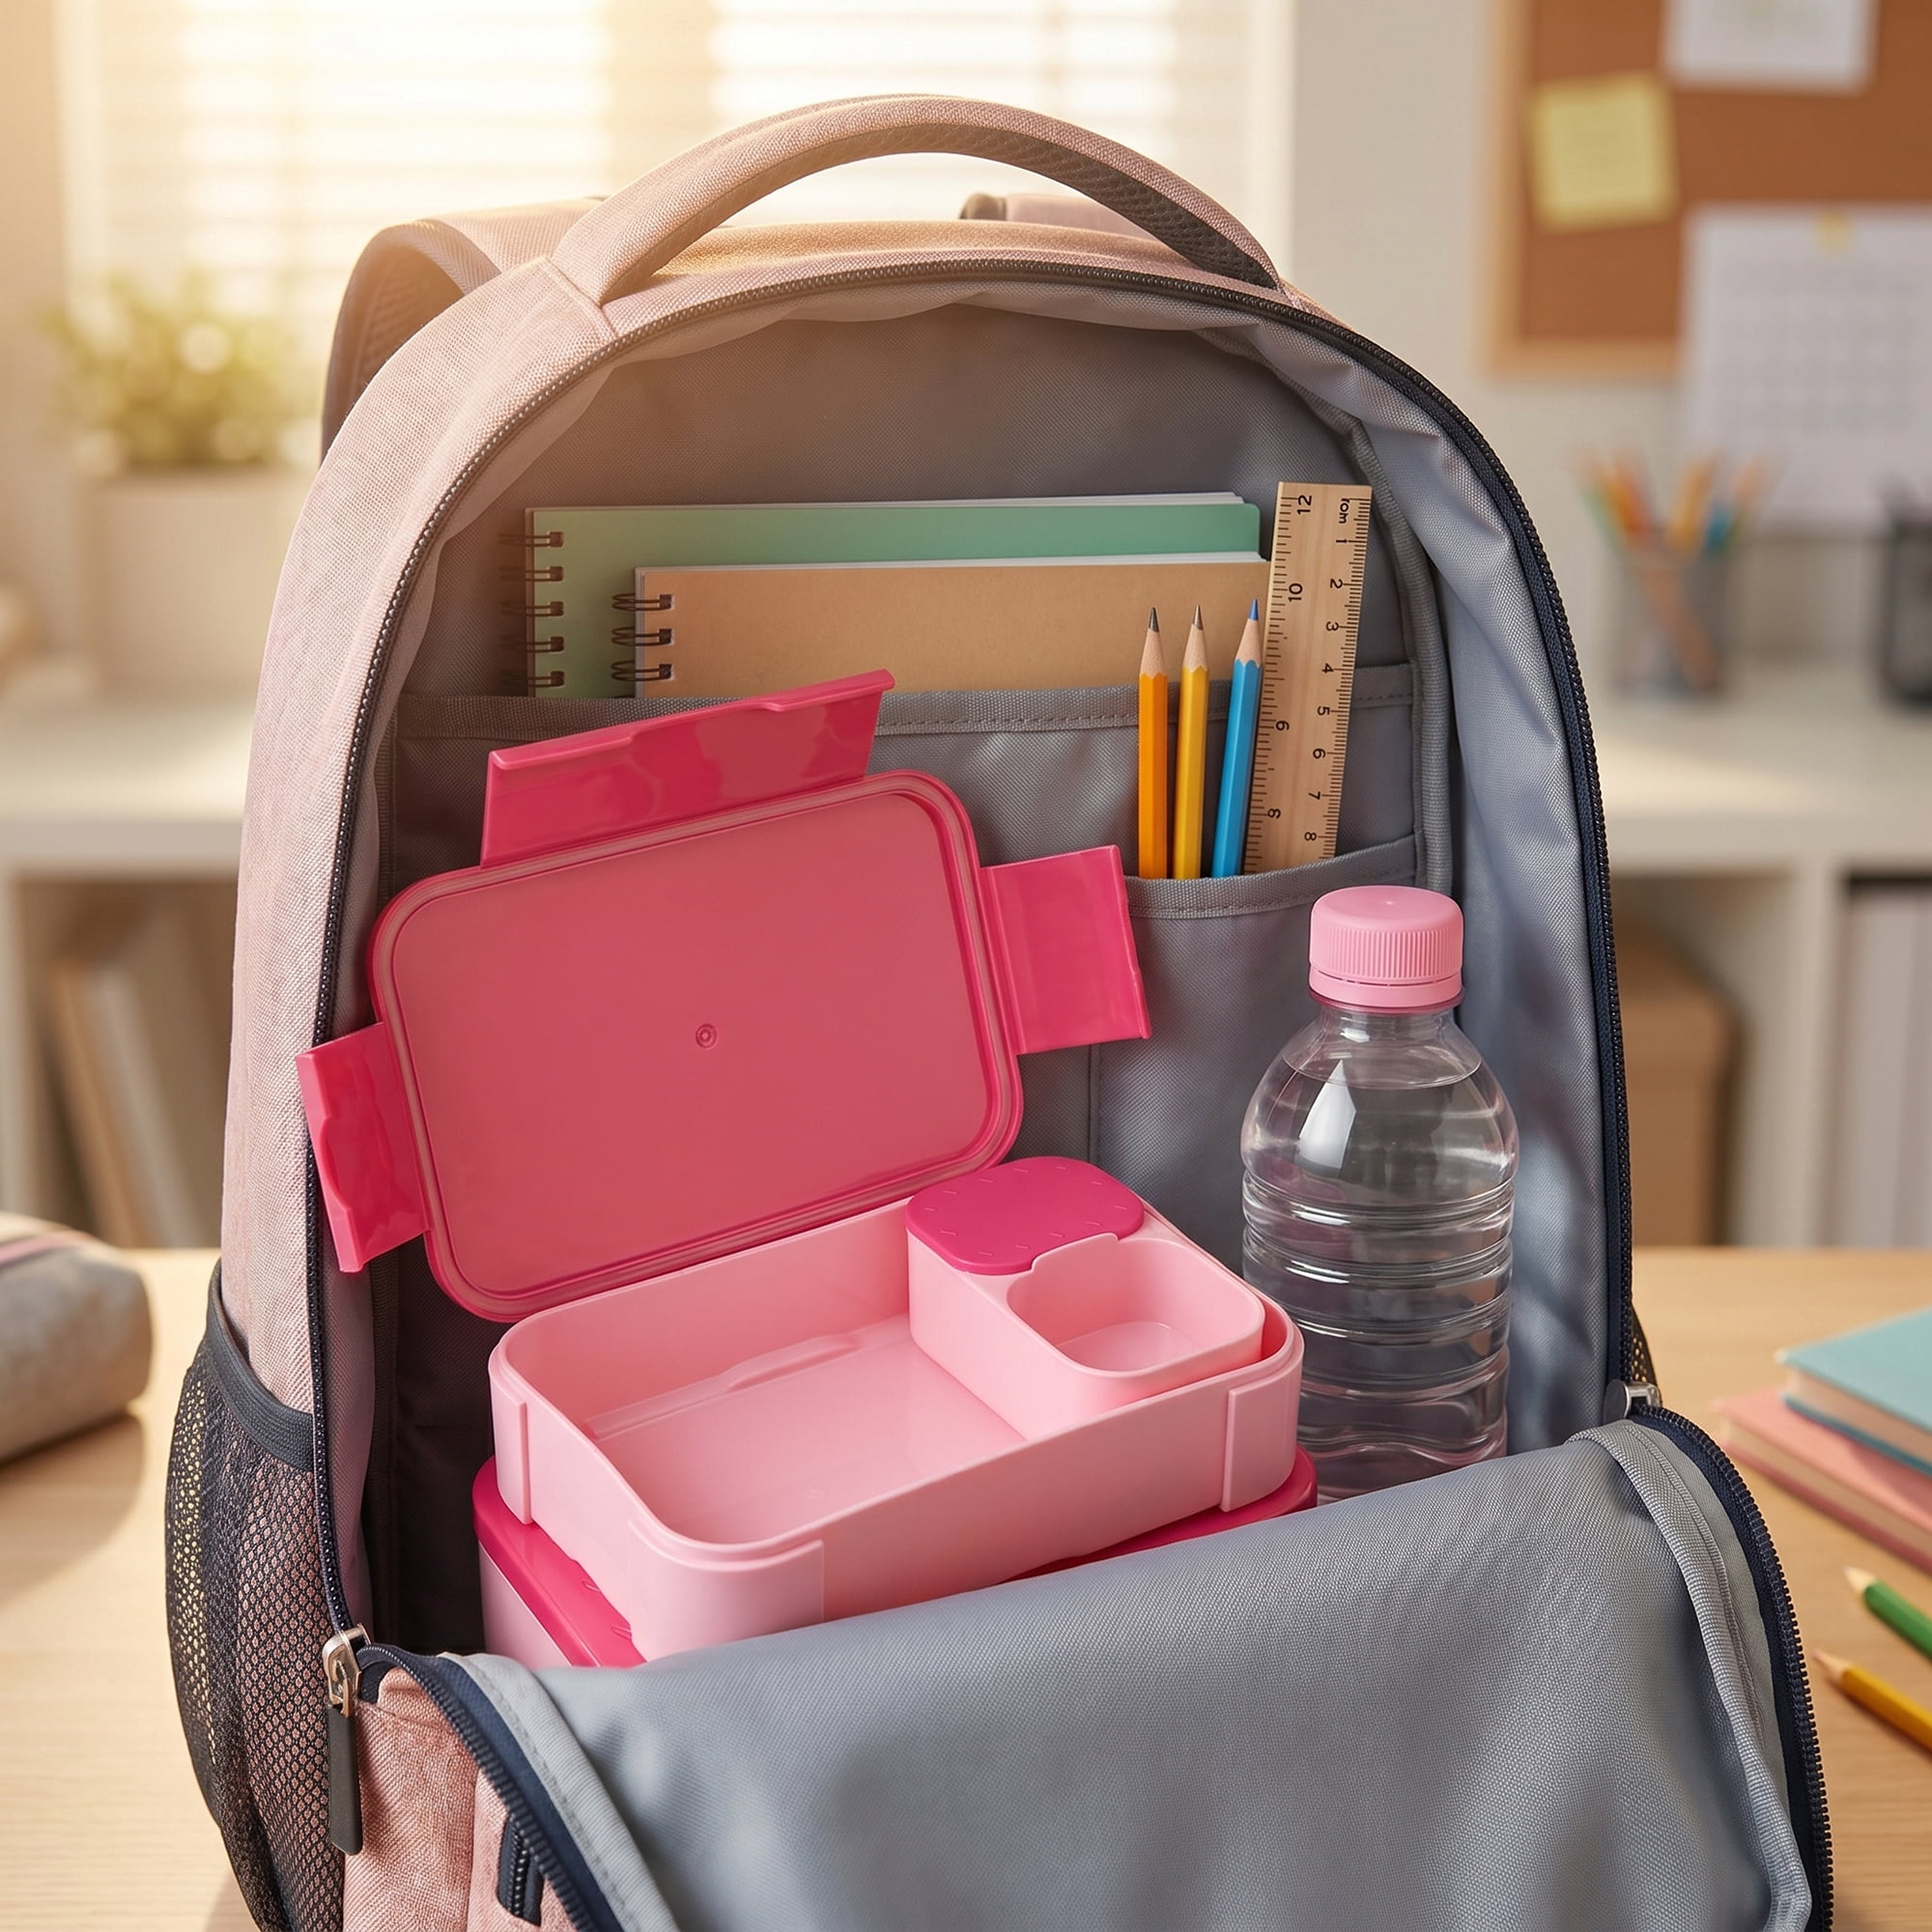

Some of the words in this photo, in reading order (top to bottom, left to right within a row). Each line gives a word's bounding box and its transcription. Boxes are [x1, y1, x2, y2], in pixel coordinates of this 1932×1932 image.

[1288, 583, 1302, 602] 10
[1296, 495, 1312, 515] 12
[1330, 579, 1343, 589] 2
[1326, 621, 1339, 632] 3
[1321, 663, 1334, 673] 4
[1317, 706, 1330, 716] 5
[1313, 748, 1325, 758] 6
[1308, 791, 1321, 800] 7
[1304, 832, 1317, 841] 8
